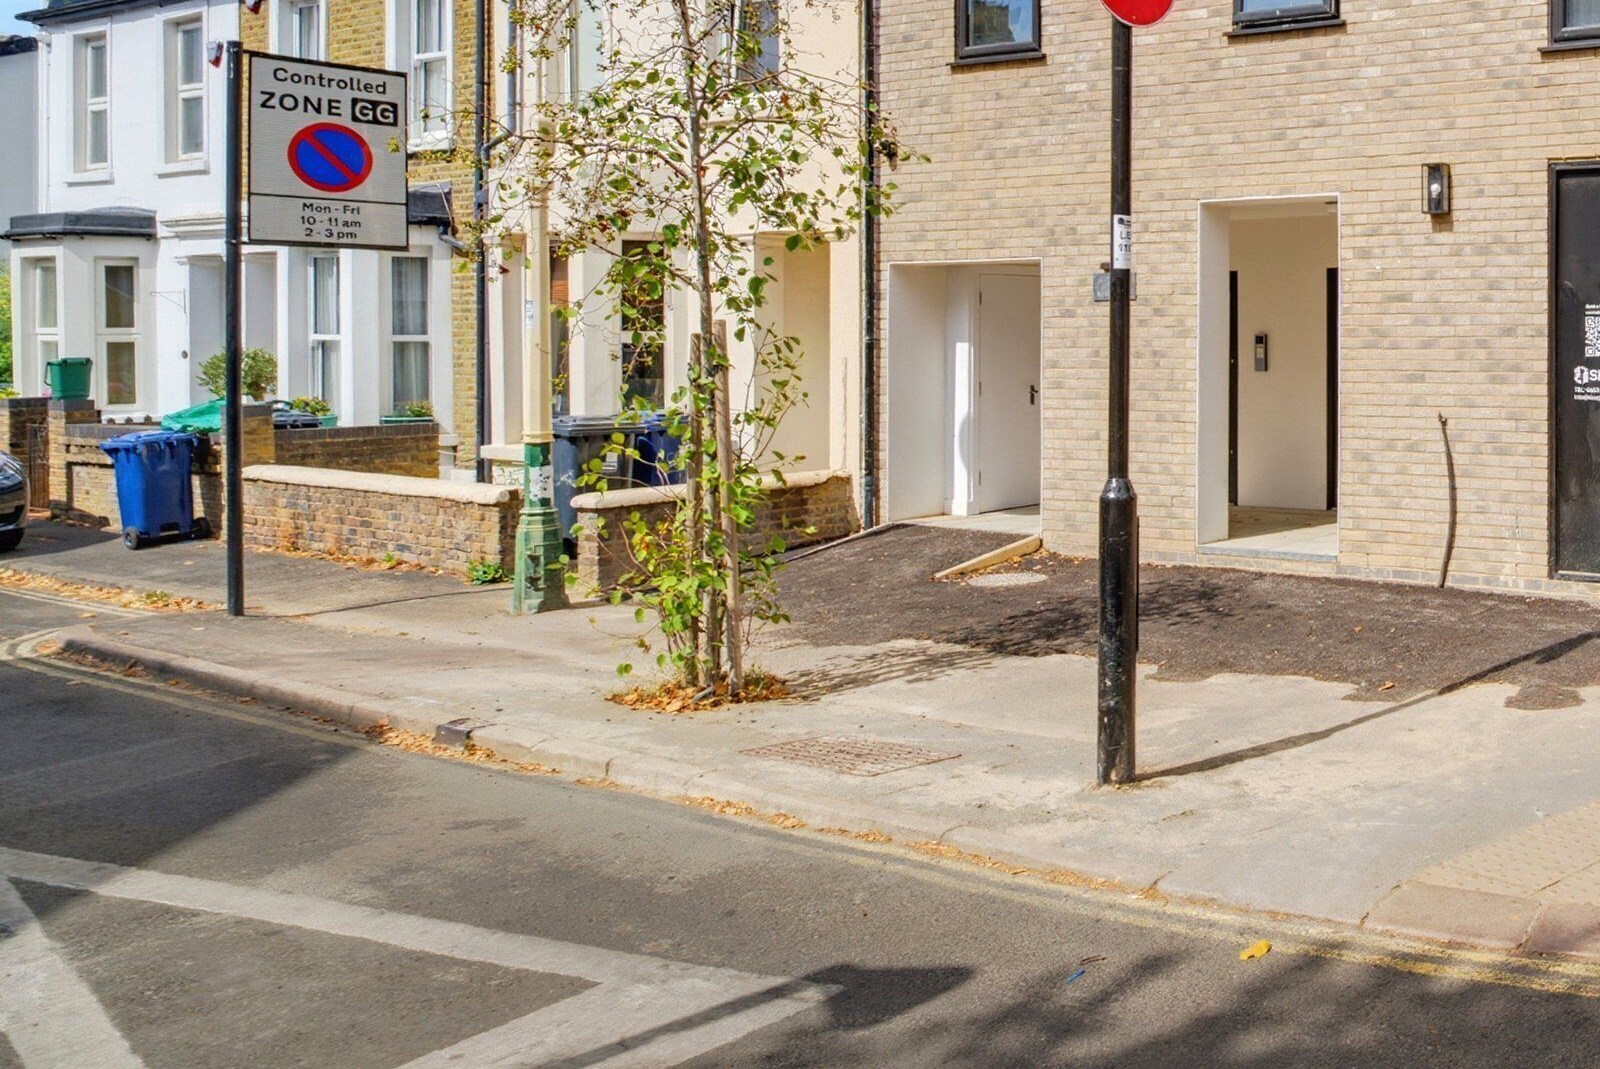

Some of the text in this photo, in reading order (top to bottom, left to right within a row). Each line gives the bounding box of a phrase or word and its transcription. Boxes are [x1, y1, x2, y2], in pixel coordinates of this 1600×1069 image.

[273, 67, 387, 95] Controlled
[260, 90, 395, 123] ZONE GG
[302, 202, 332, 213] Mon
[343, 205, 360, 214] Fri
[301, 215, 316, 225] 10
[328, 217, 339, 227] 11
[342, 220, 362, 228] am
[305, 227, 314, 237] 2
[324, 228, 334, 238] 3
[337, 231, 357, 240] pm
